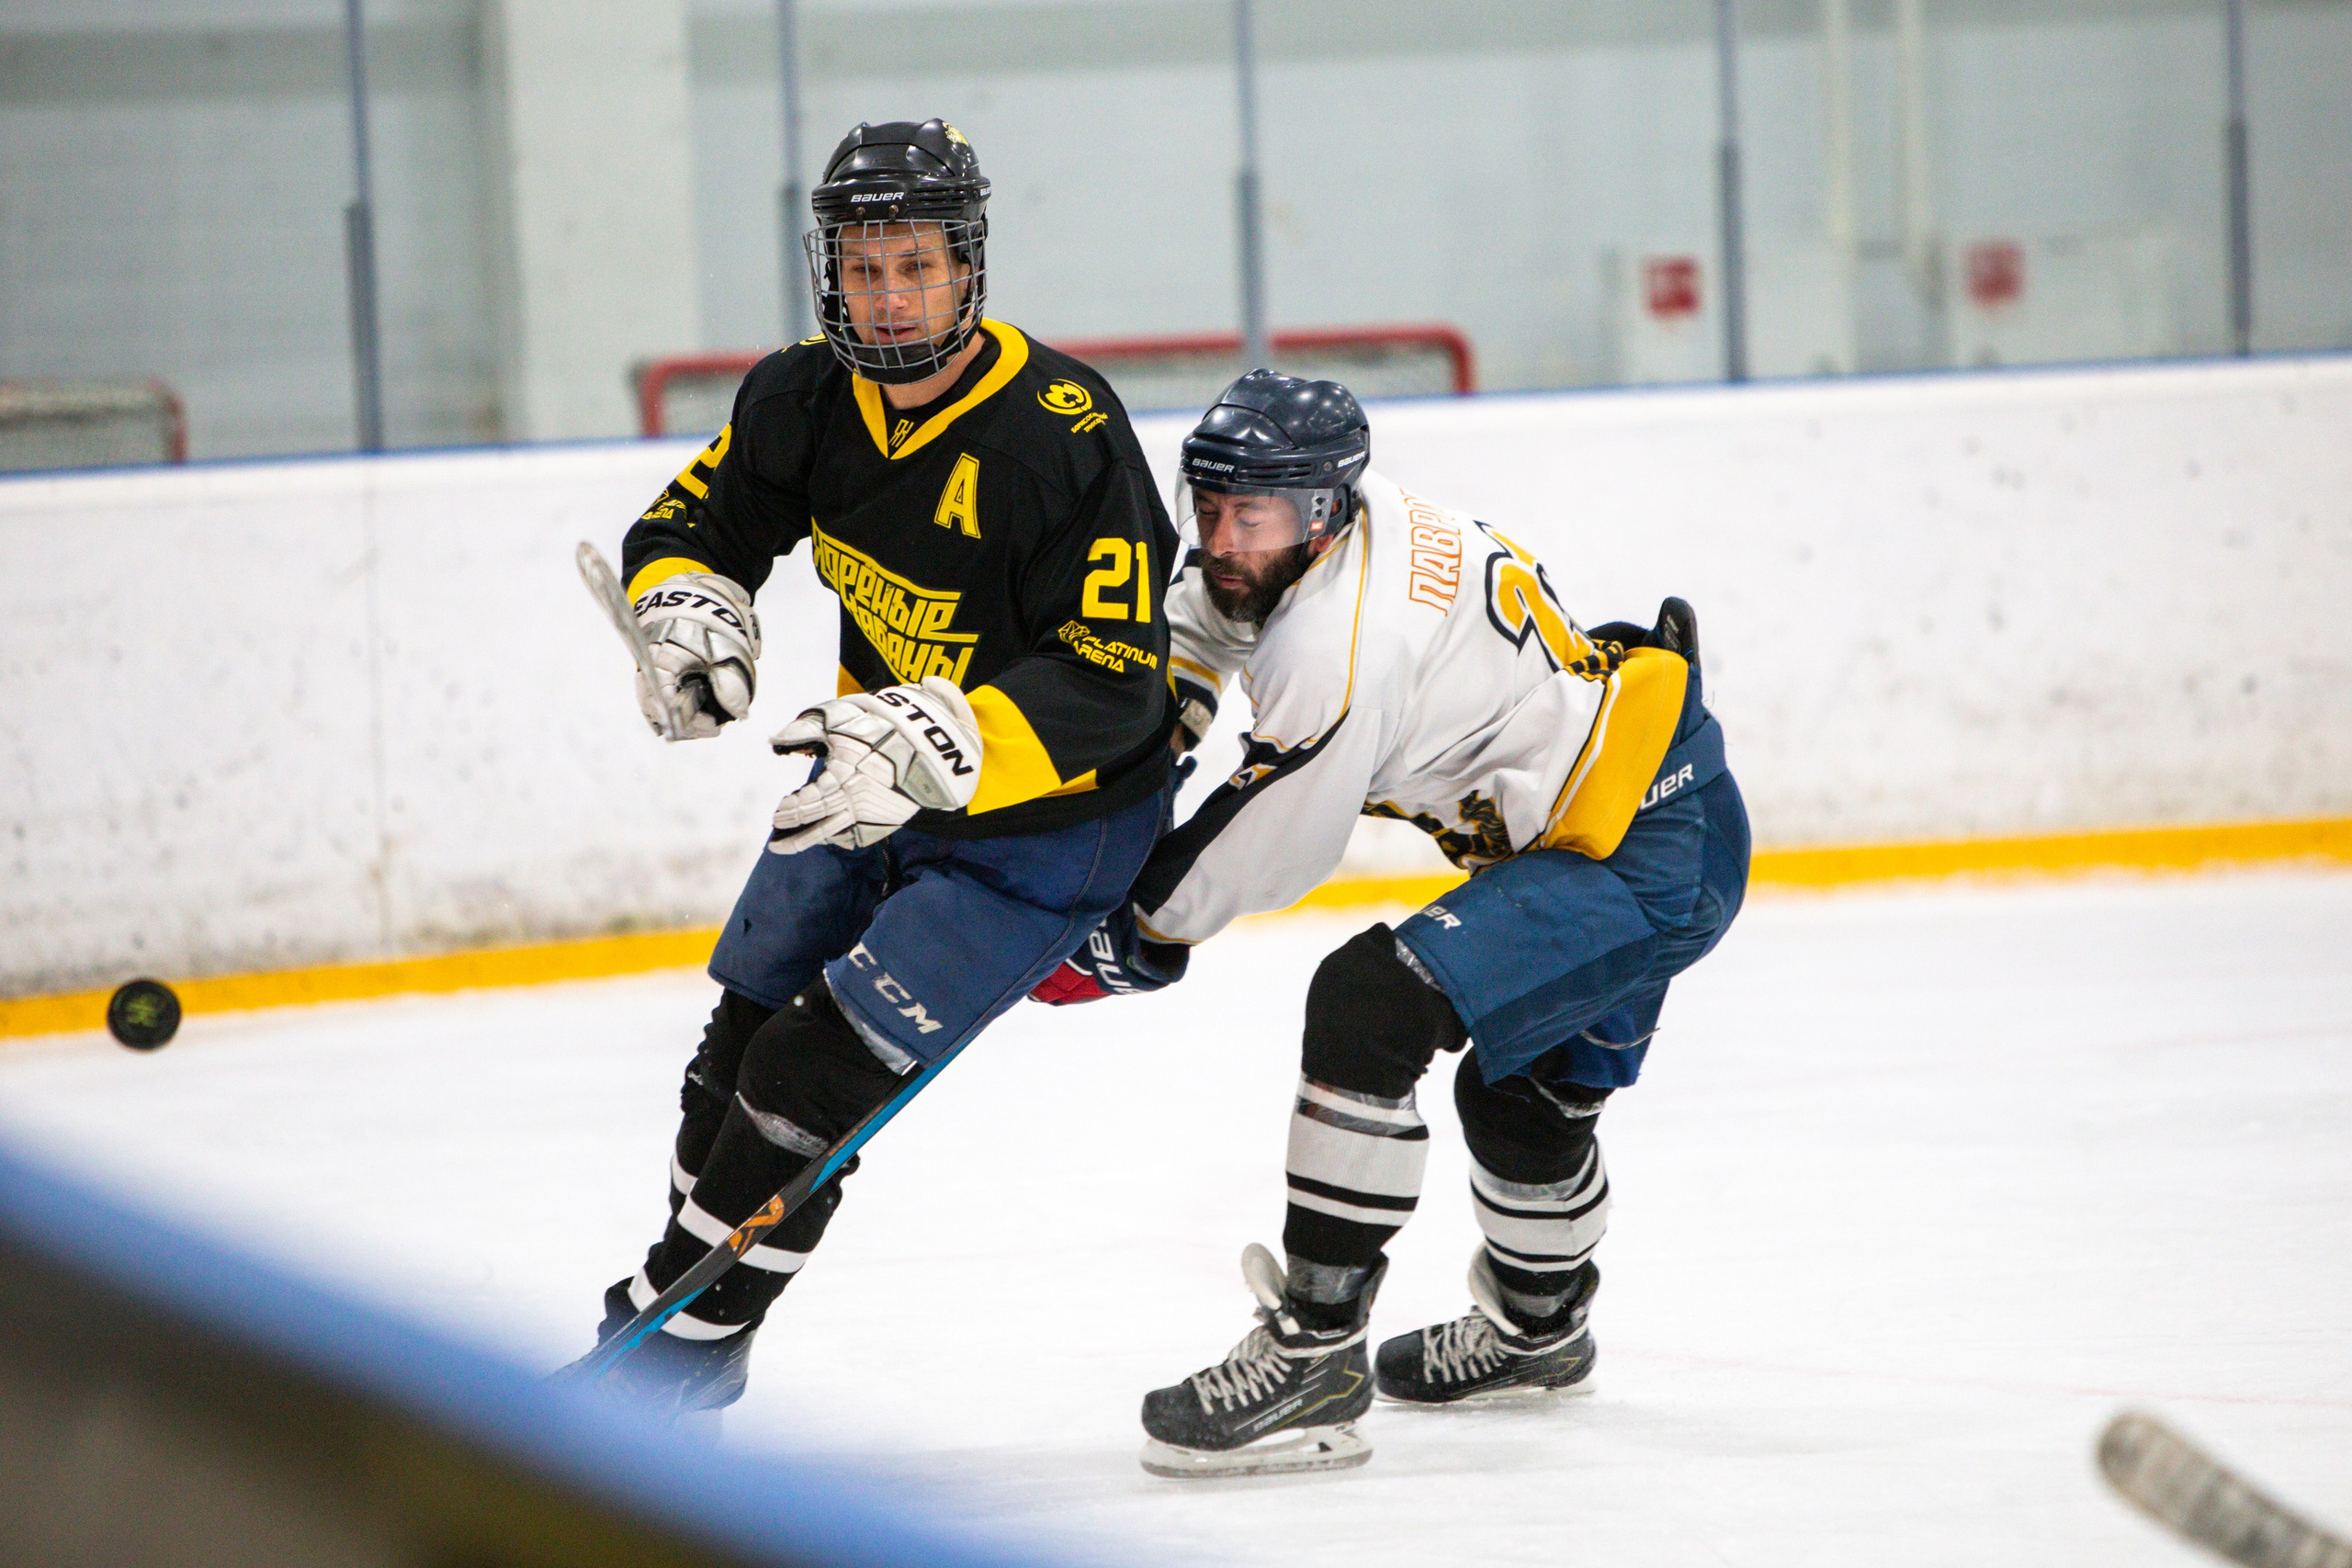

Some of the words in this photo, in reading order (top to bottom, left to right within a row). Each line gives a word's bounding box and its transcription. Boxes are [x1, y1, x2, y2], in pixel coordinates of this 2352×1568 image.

[850, 191, 905, 203] BAUER
[1193, 457, 1235, 473] BAUER
[1337, 451, 1365, 468] BAUER
[933, 452, 981, 539] A
[1081, 537, 1150, 624] 21
[1073, 640, 1125, 673] ARENA
[1082, 636, 1158, 671] PLATINUM
[848, 942, 944, 1034] CCM
